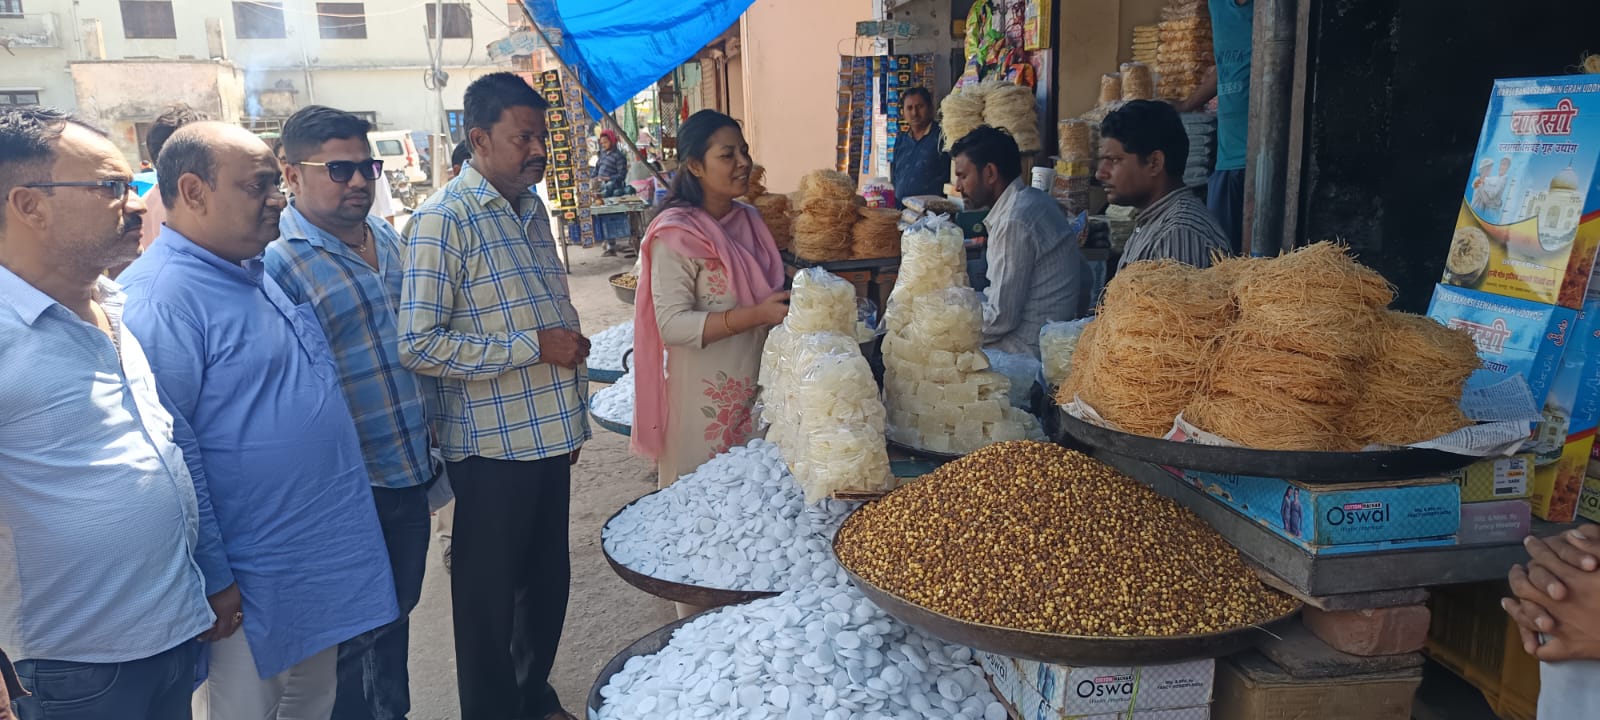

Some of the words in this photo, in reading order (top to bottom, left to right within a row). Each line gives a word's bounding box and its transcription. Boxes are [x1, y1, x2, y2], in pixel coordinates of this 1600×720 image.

[1563, 84, 1582, 94] GRAH
[1510, 97, 1579, 136] वारसी
[1542, 143, 1555, 155] गृह
[1326, 503, 1390, 528] Oswal
[1076, 679, 1133, 699] Oswa
